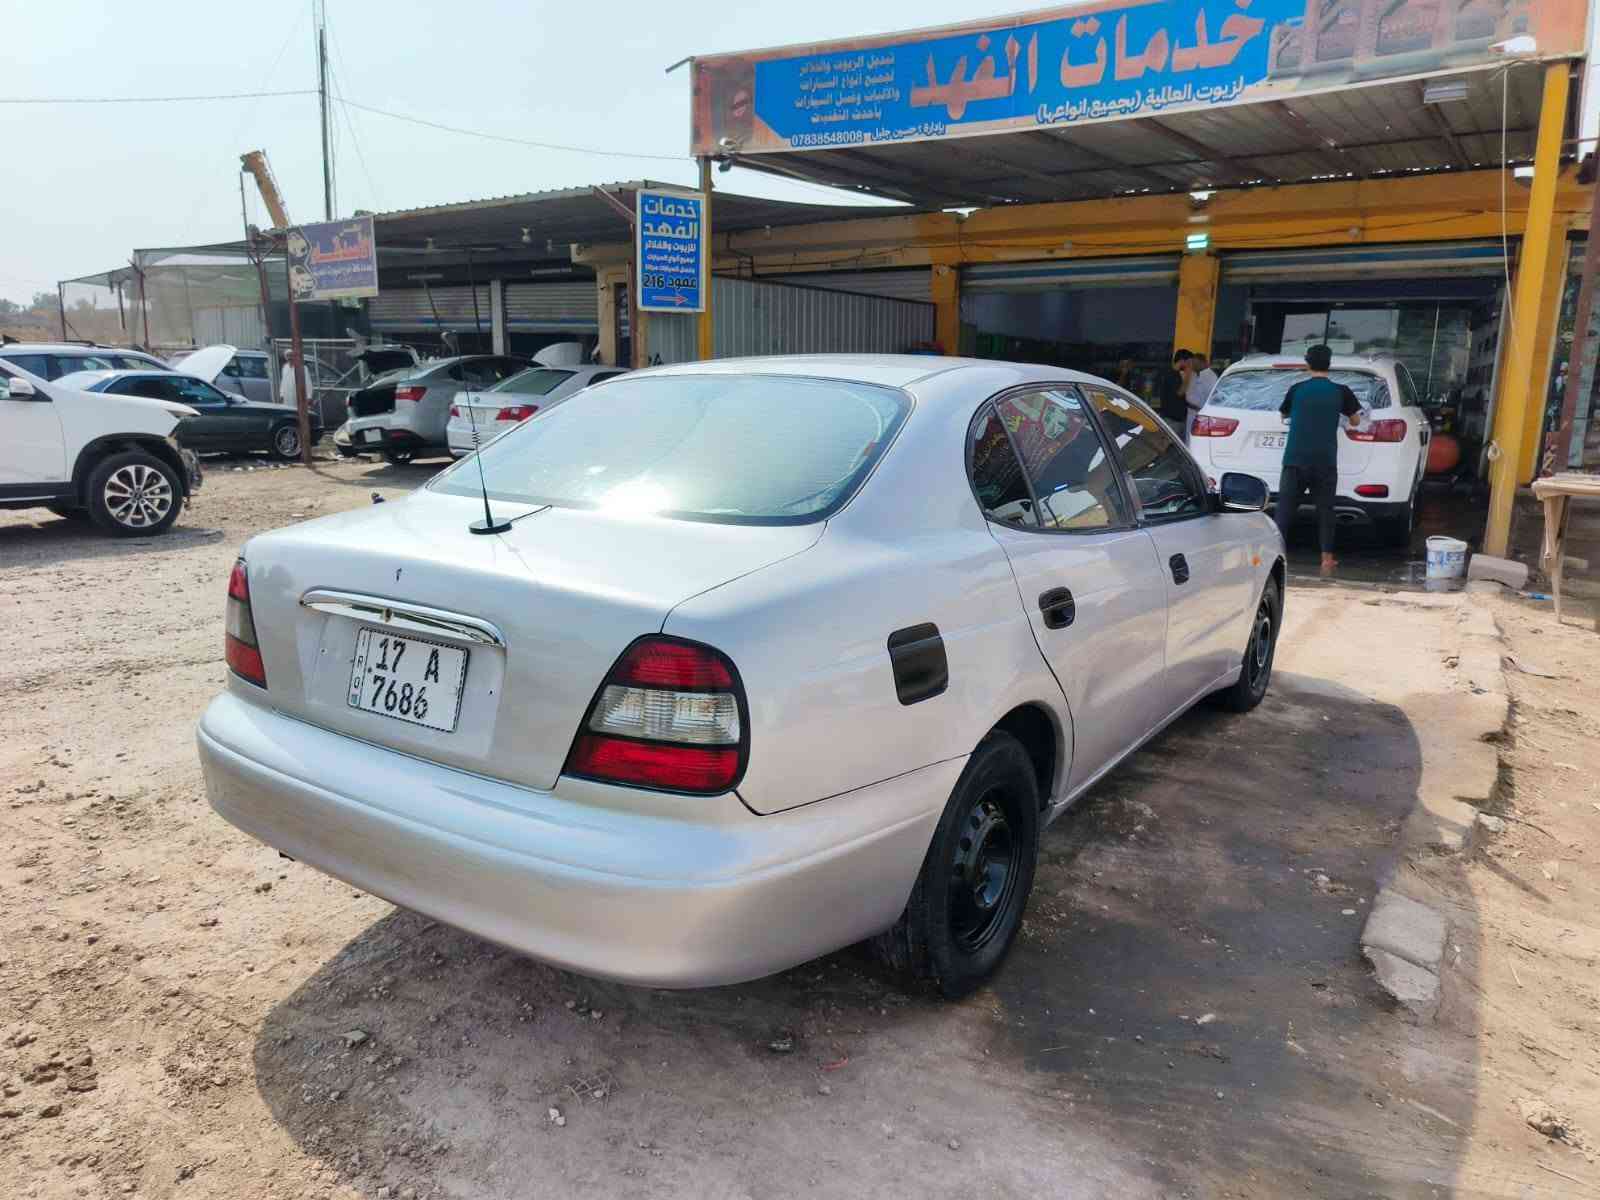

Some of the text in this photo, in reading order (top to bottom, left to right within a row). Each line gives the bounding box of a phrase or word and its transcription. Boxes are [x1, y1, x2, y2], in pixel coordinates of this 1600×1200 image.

[910, 0, 1265, 120] خدمات الفهد
[1145, 83, 1192, 108] العالمية
[644, 197, 697, 220] خدمات
[643, 220, 698, 240] الفهد
[641, 272, 697, 292] عمود 216
[1262, 436, 1274, 447] 22
[375, 638, 440, 684] 17 A
[371, 674, 429, 720] 7686
